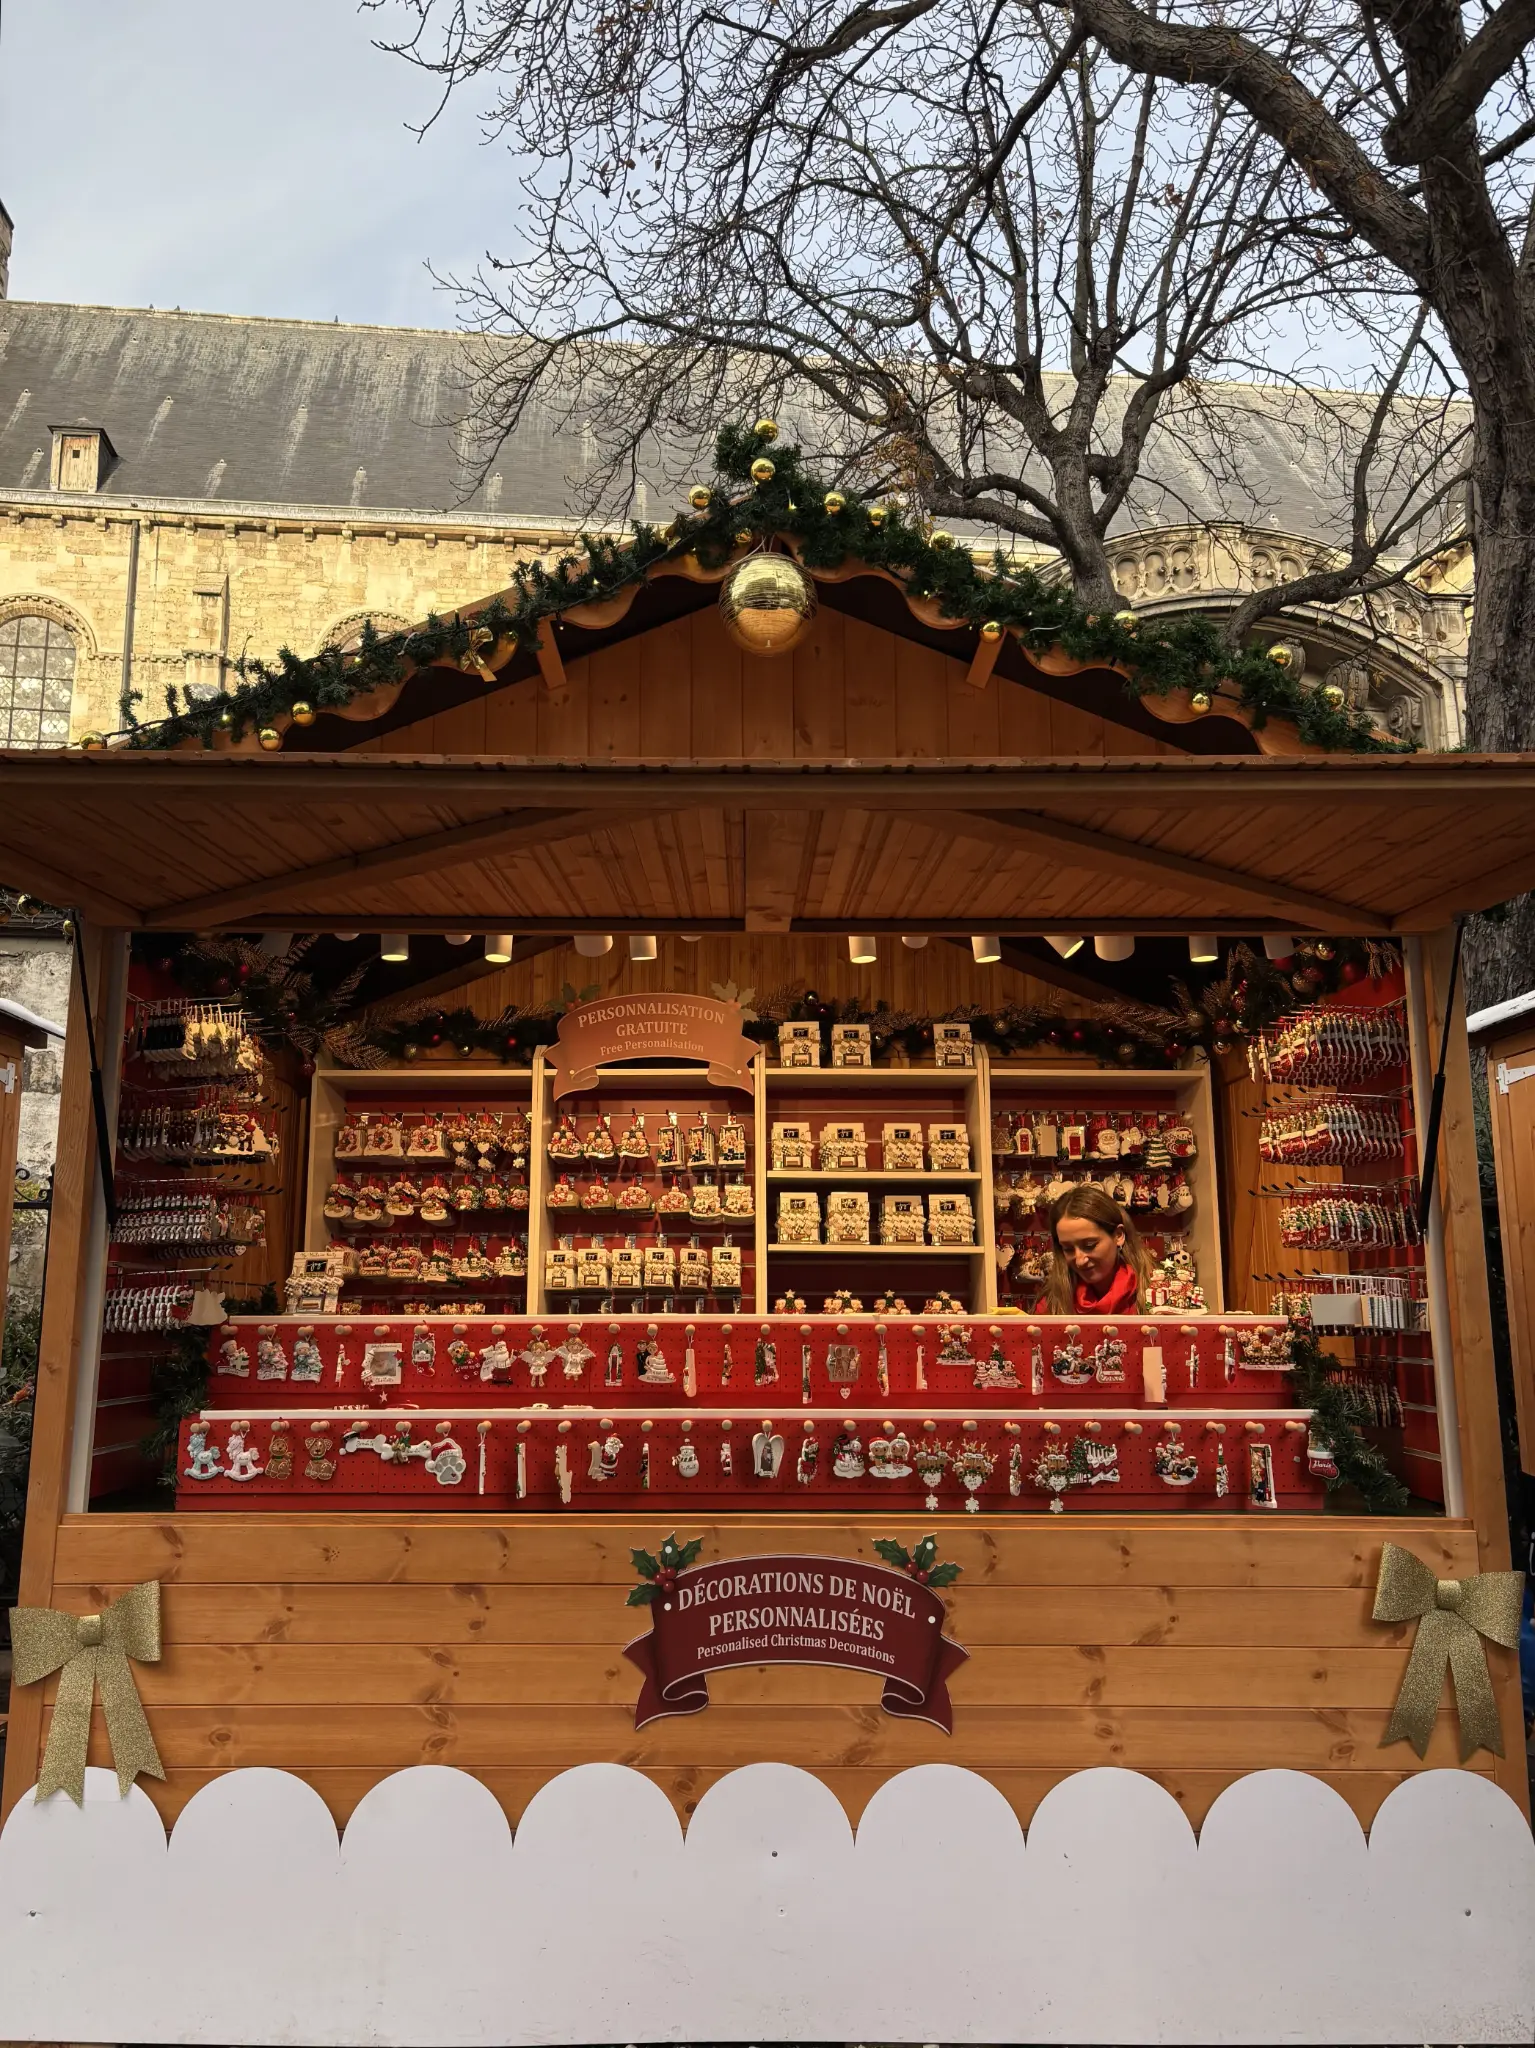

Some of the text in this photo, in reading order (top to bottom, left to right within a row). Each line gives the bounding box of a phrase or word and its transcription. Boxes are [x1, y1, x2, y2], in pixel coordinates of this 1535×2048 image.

[577, 1002, 725, 1028] PERSONNALISATION
[616, 1021, 688, 1037] GRATUITE
[600, 1038, 704, 1056] Free Personalisation
[677, 1571, 916, 1619] DÉCORATIONS DE NOËL
[709, 1605, 884, 1641] PERSONNALISÉES
[696, 1633, 895, 1665] Personalised Christmas Decorations
